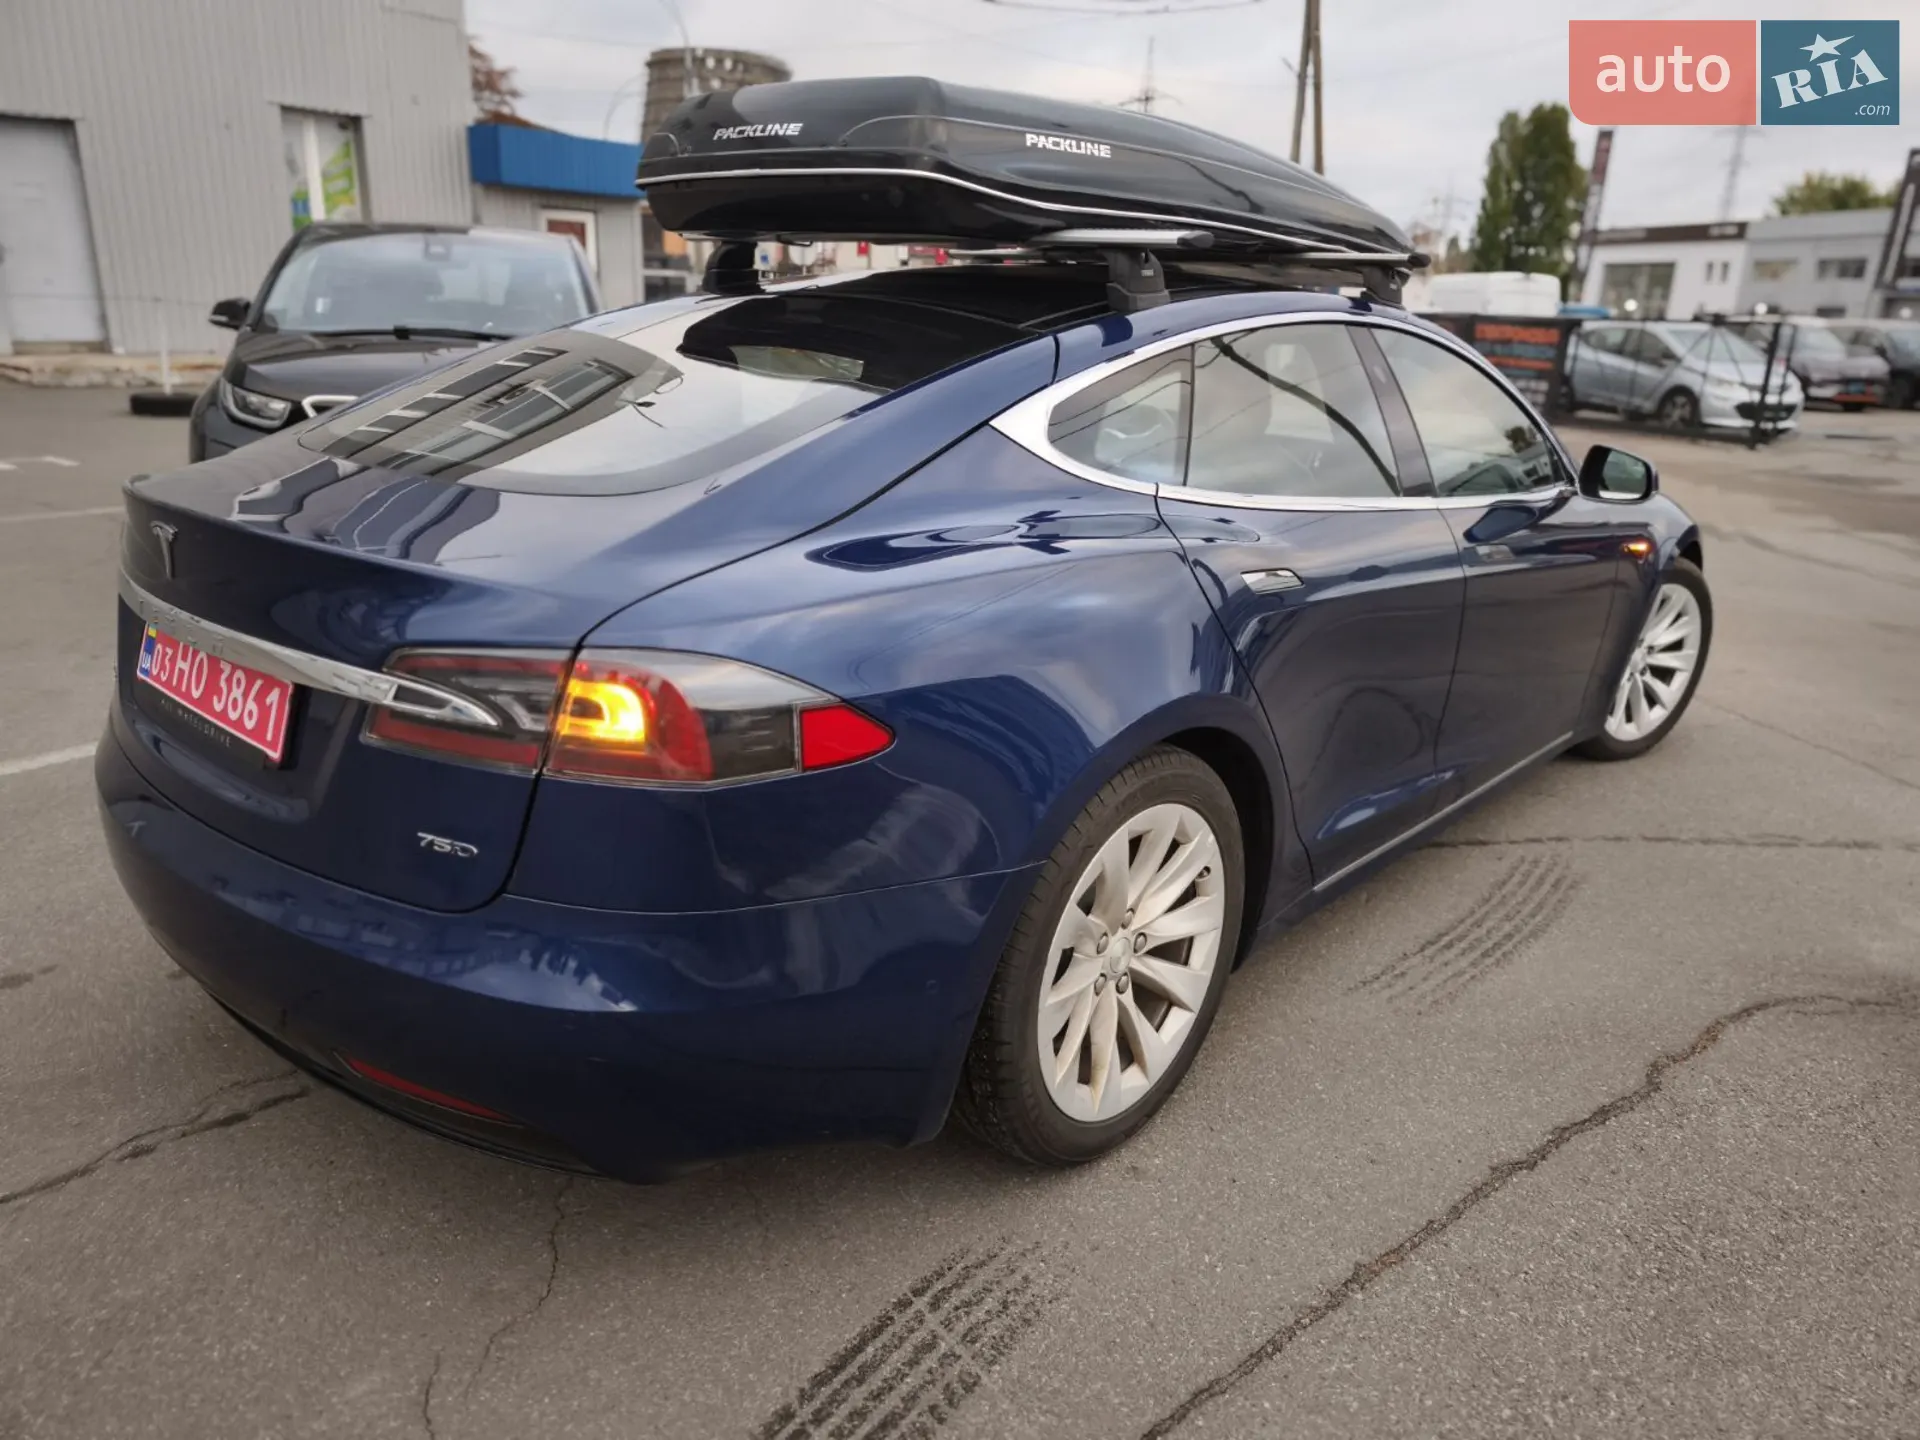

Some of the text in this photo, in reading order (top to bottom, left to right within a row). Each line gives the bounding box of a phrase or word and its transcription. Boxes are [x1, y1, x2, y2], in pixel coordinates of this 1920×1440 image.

[712, 122, 804, 141] PACKLINE
[1025, 132, 1112, 158] PACKLINE
[212, 659, 281, 742] 3861
[416, 831, 479, 858] 75D
